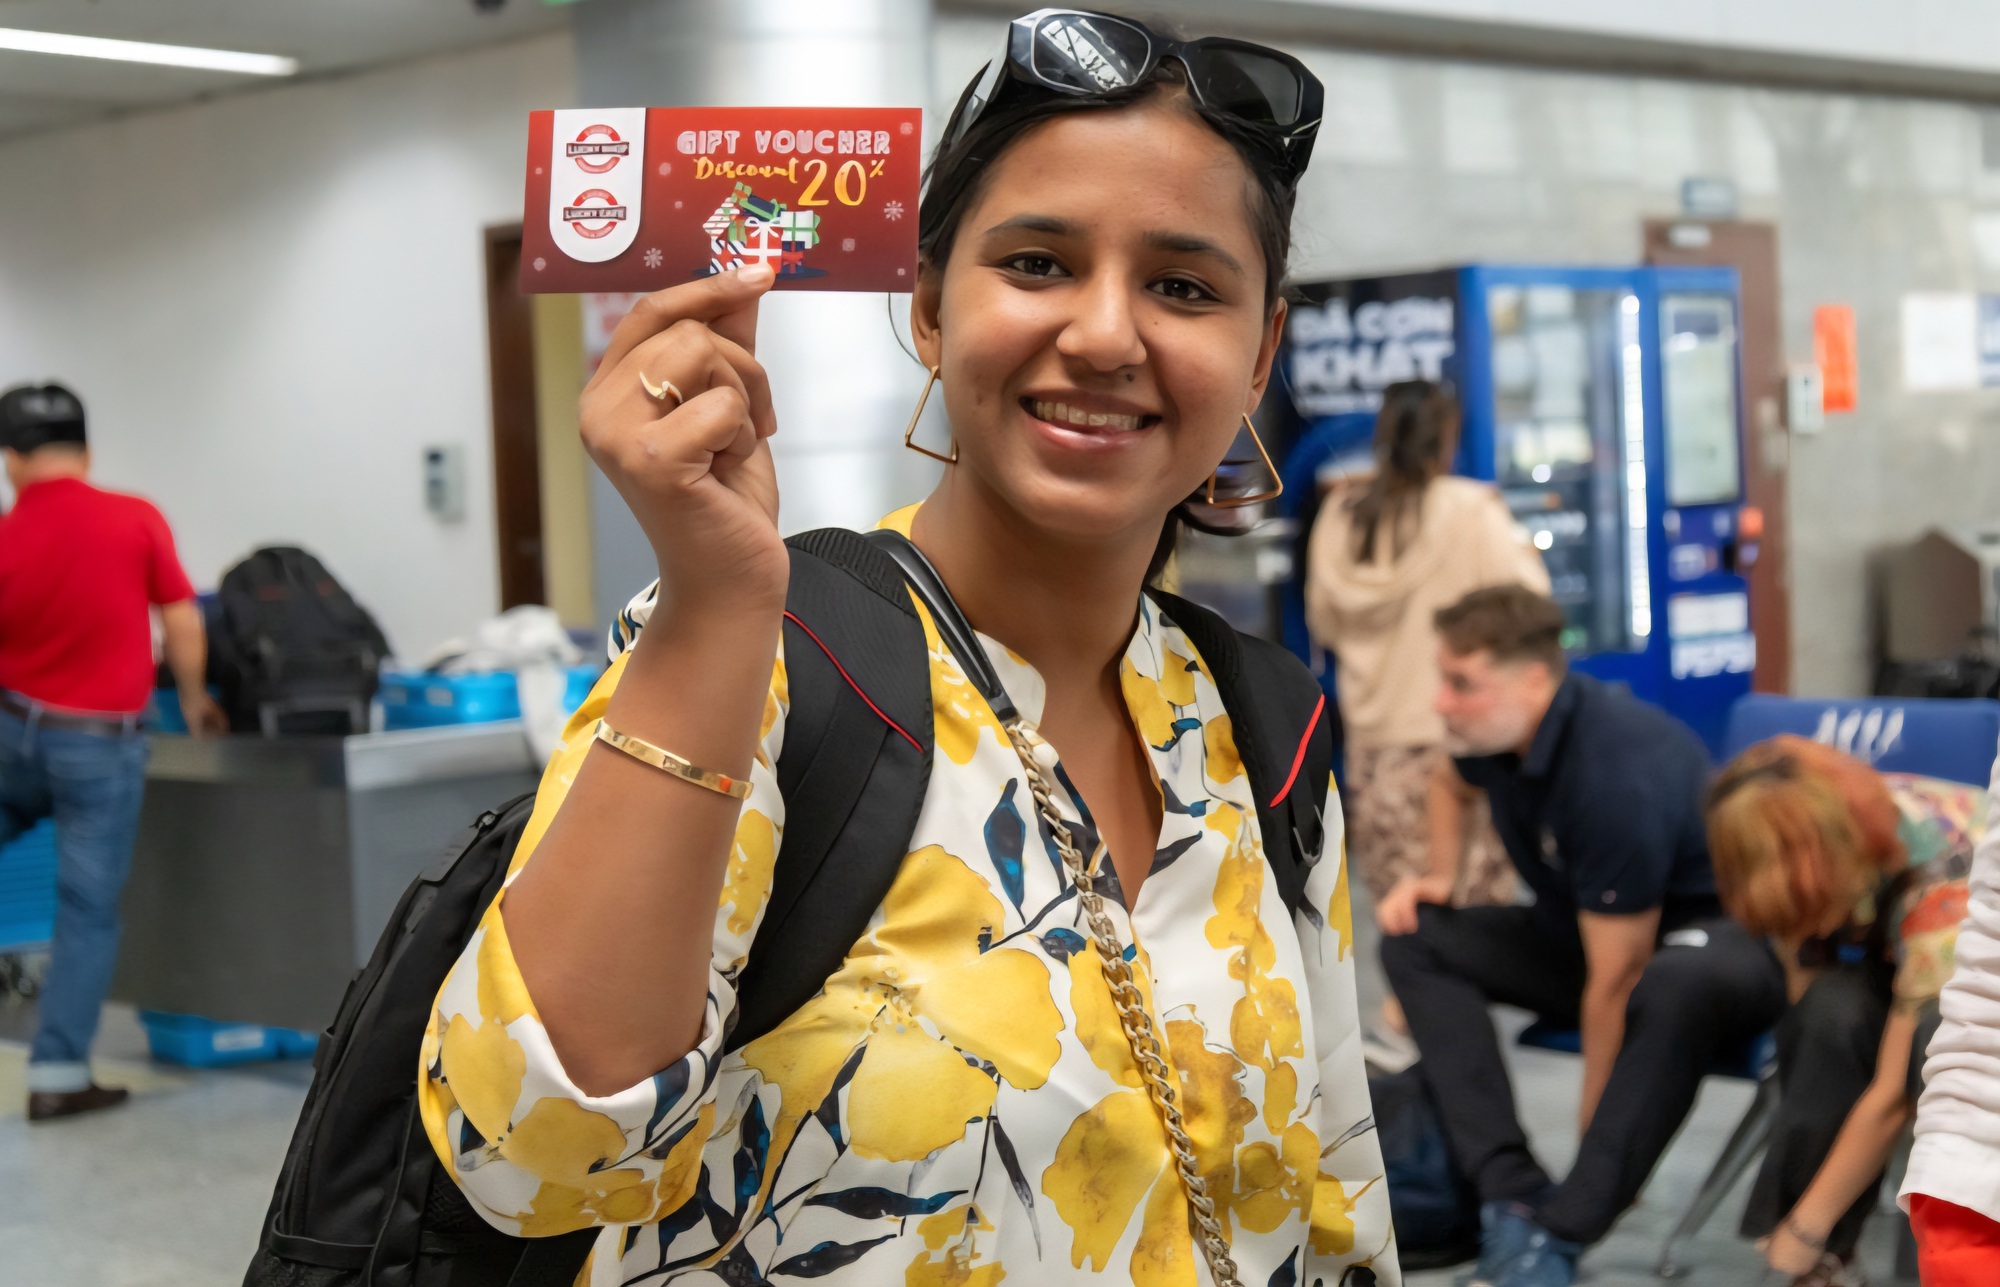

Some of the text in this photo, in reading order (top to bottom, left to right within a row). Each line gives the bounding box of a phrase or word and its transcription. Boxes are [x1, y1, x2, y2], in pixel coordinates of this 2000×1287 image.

[676, 129, 890, 154] GIFT VOUCHER
[694, 156, 799, 184] Discount
